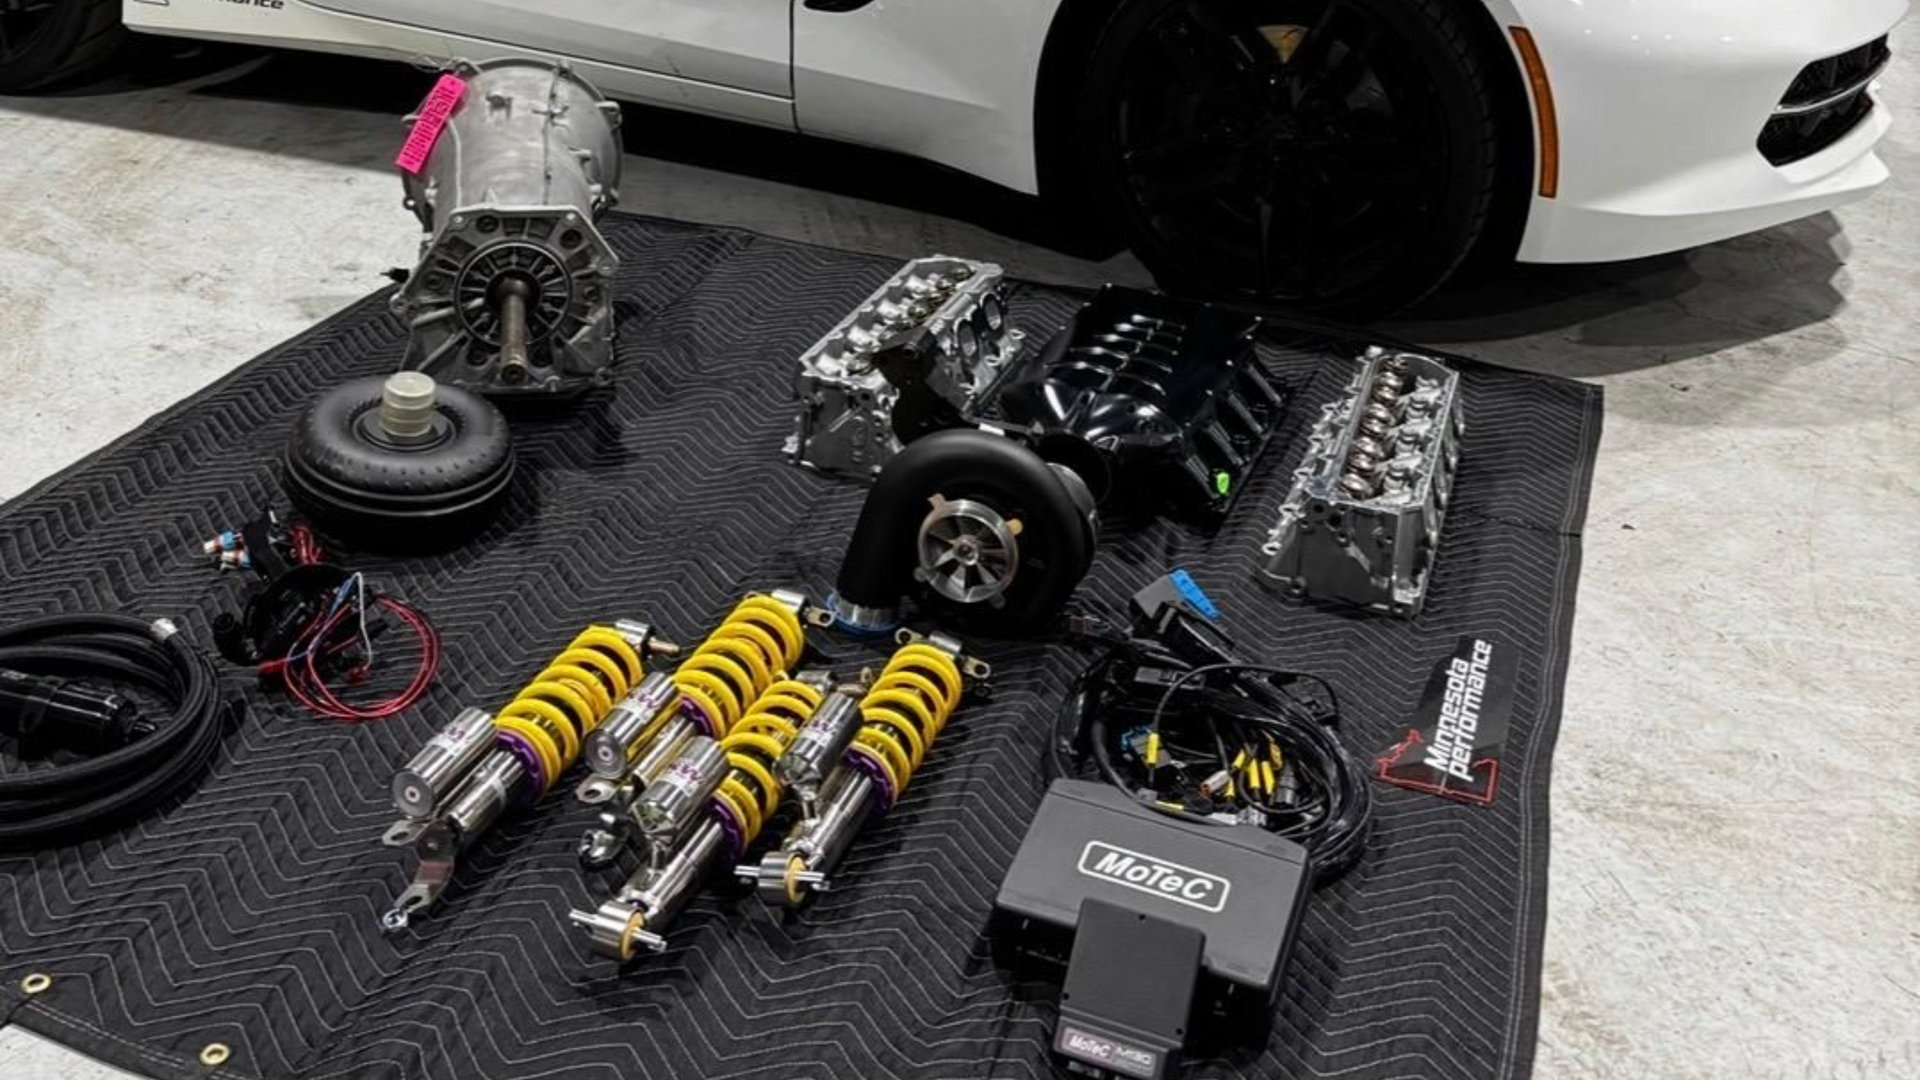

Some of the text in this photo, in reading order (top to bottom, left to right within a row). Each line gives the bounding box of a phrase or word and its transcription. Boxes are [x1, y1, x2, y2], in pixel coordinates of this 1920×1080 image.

[1424, 657, 1469, 772] Minnesota
[1449, 639, 1493, 782] performance
[1094, 852, 1214, 900] MoTeC
[1069, 1034, 1111, 1058] MoTeC
